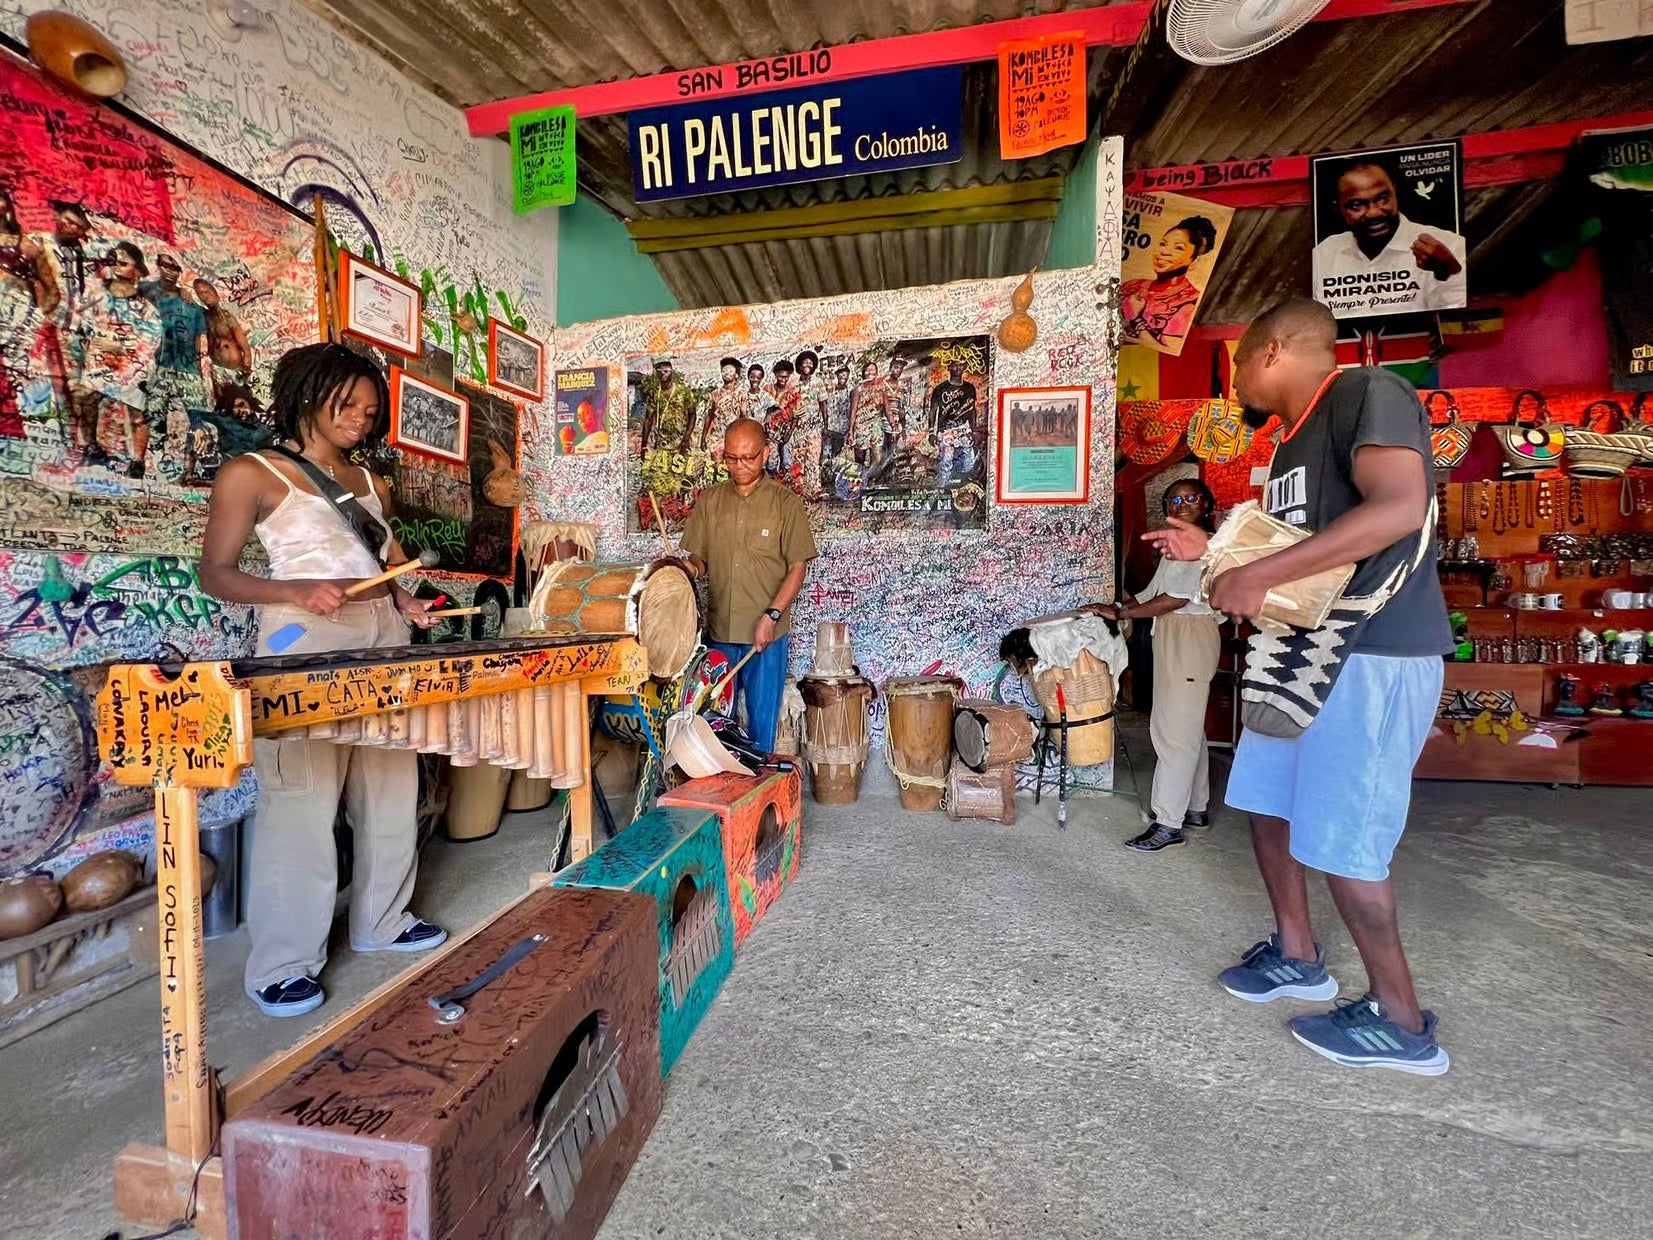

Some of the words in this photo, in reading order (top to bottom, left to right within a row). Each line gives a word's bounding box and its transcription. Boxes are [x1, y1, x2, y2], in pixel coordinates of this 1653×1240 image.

[677, 70, 723, 96] SAN
[735, 49, 832, 89] BASILIO
[639, 123, 673, 189] RI
[684, 98, 843, 184] PALENGE
[855, 124, 949, 161] Colombia
[1400, 155, 1416, 163] UN
[1142, 168, 1196, 188] being
[1199, 160, 1273, 187] Black
[1405, 164, 1451, 177] OLVIDAR
[1125, 197, 1163, 217] VIVIR
[1323, 270, 1411, 287] DIONISIO
[1323, 281, 1421, 299] MIRANDA
[1328, 299, 1366, 311] Siempre
[1368, 292, 1417, 309] Presente!
[557, 371, 595, 382] FRANCIA
[327, 679, 378, 705] CATA
[182, 747, 218, 770] Yuri
[163, 884, 178, 978] SOFI
